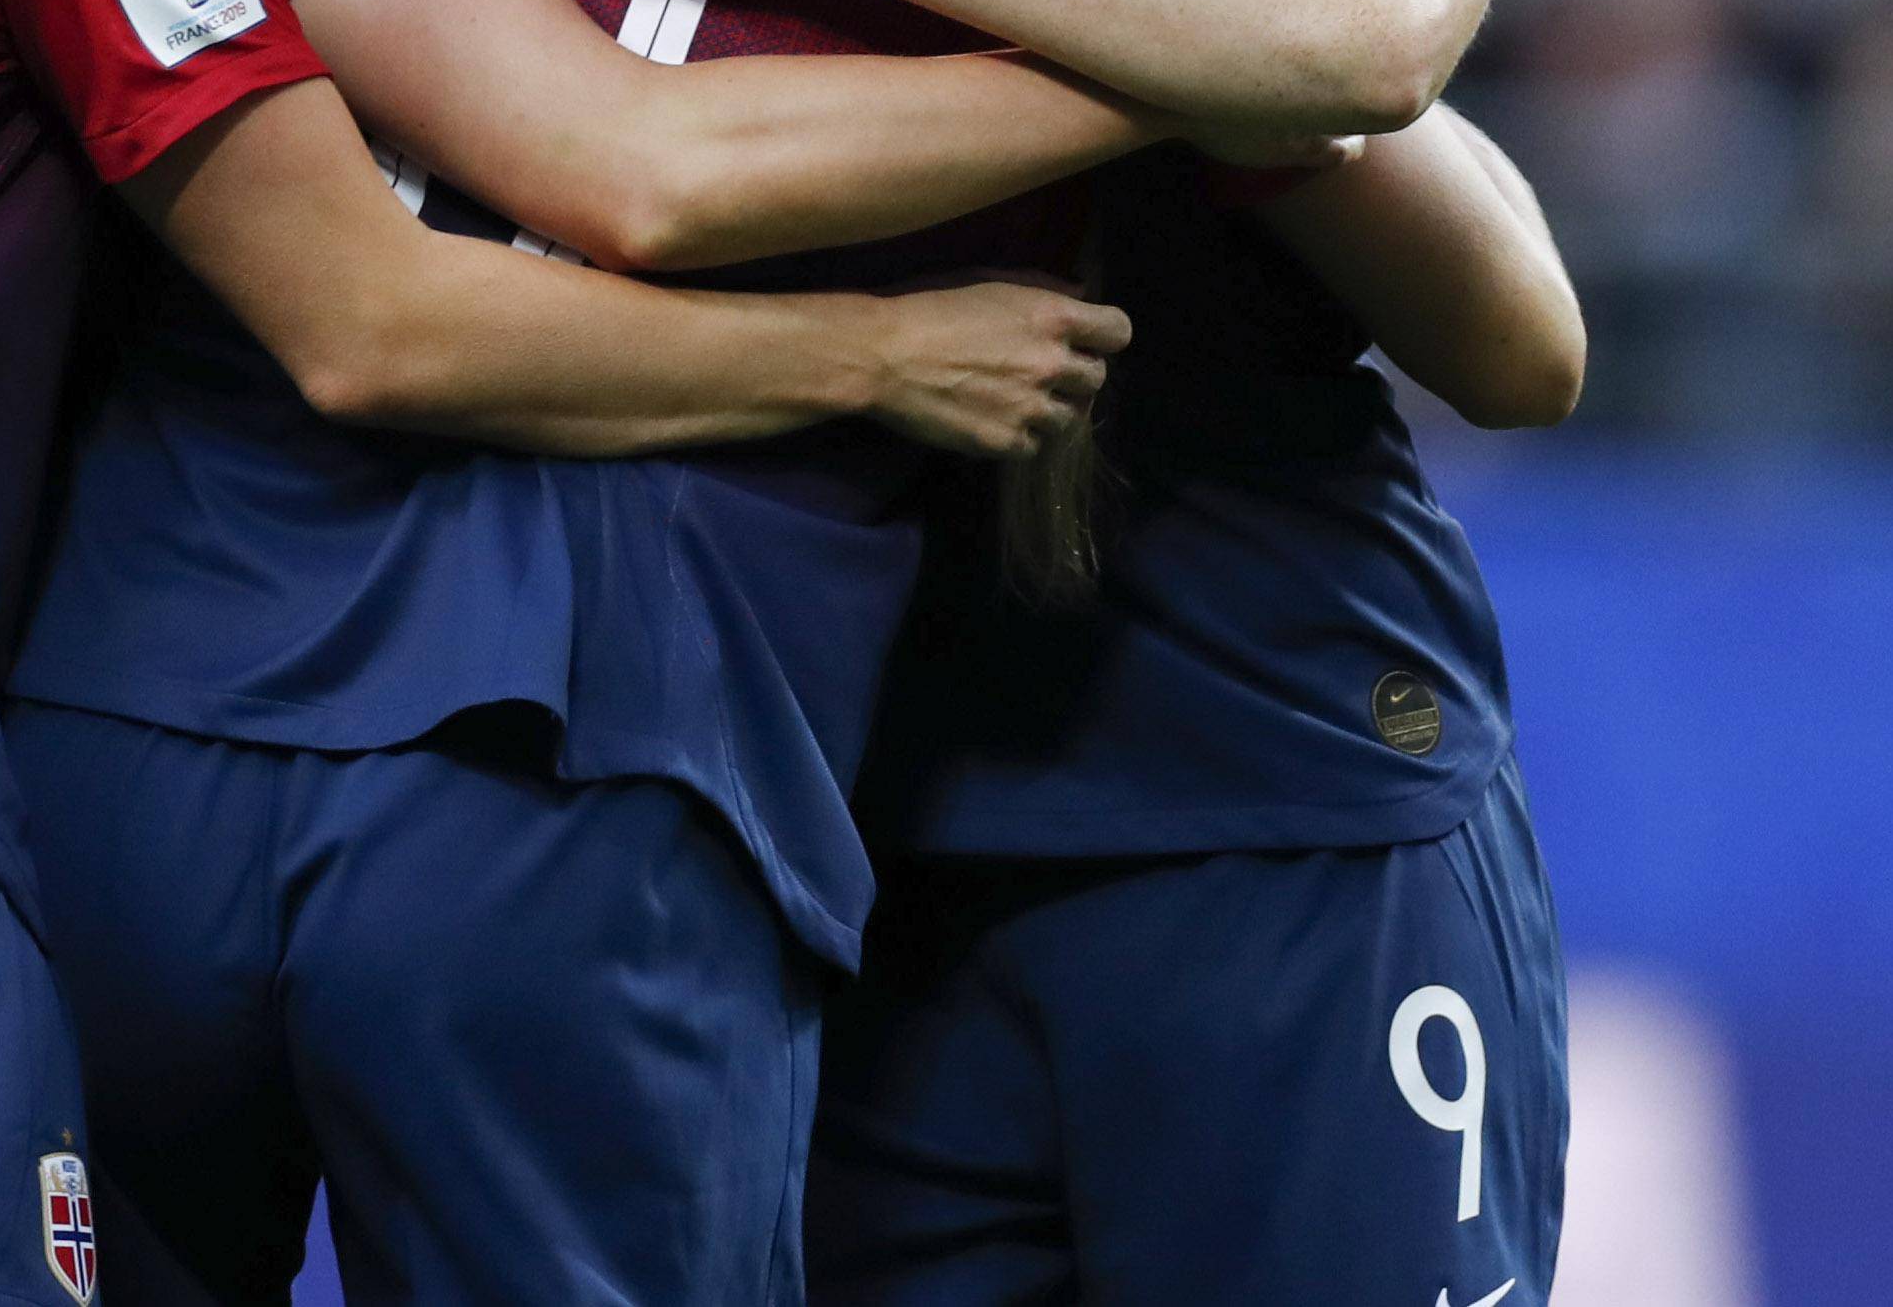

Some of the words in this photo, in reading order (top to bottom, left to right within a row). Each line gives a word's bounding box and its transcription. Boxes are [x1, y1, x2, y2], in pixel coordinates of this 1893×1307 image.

[166, 14, 223, 50] FRANCE
[218, 1, 247, 24] 2019
[1388, 984, 1486, 1223] 9
